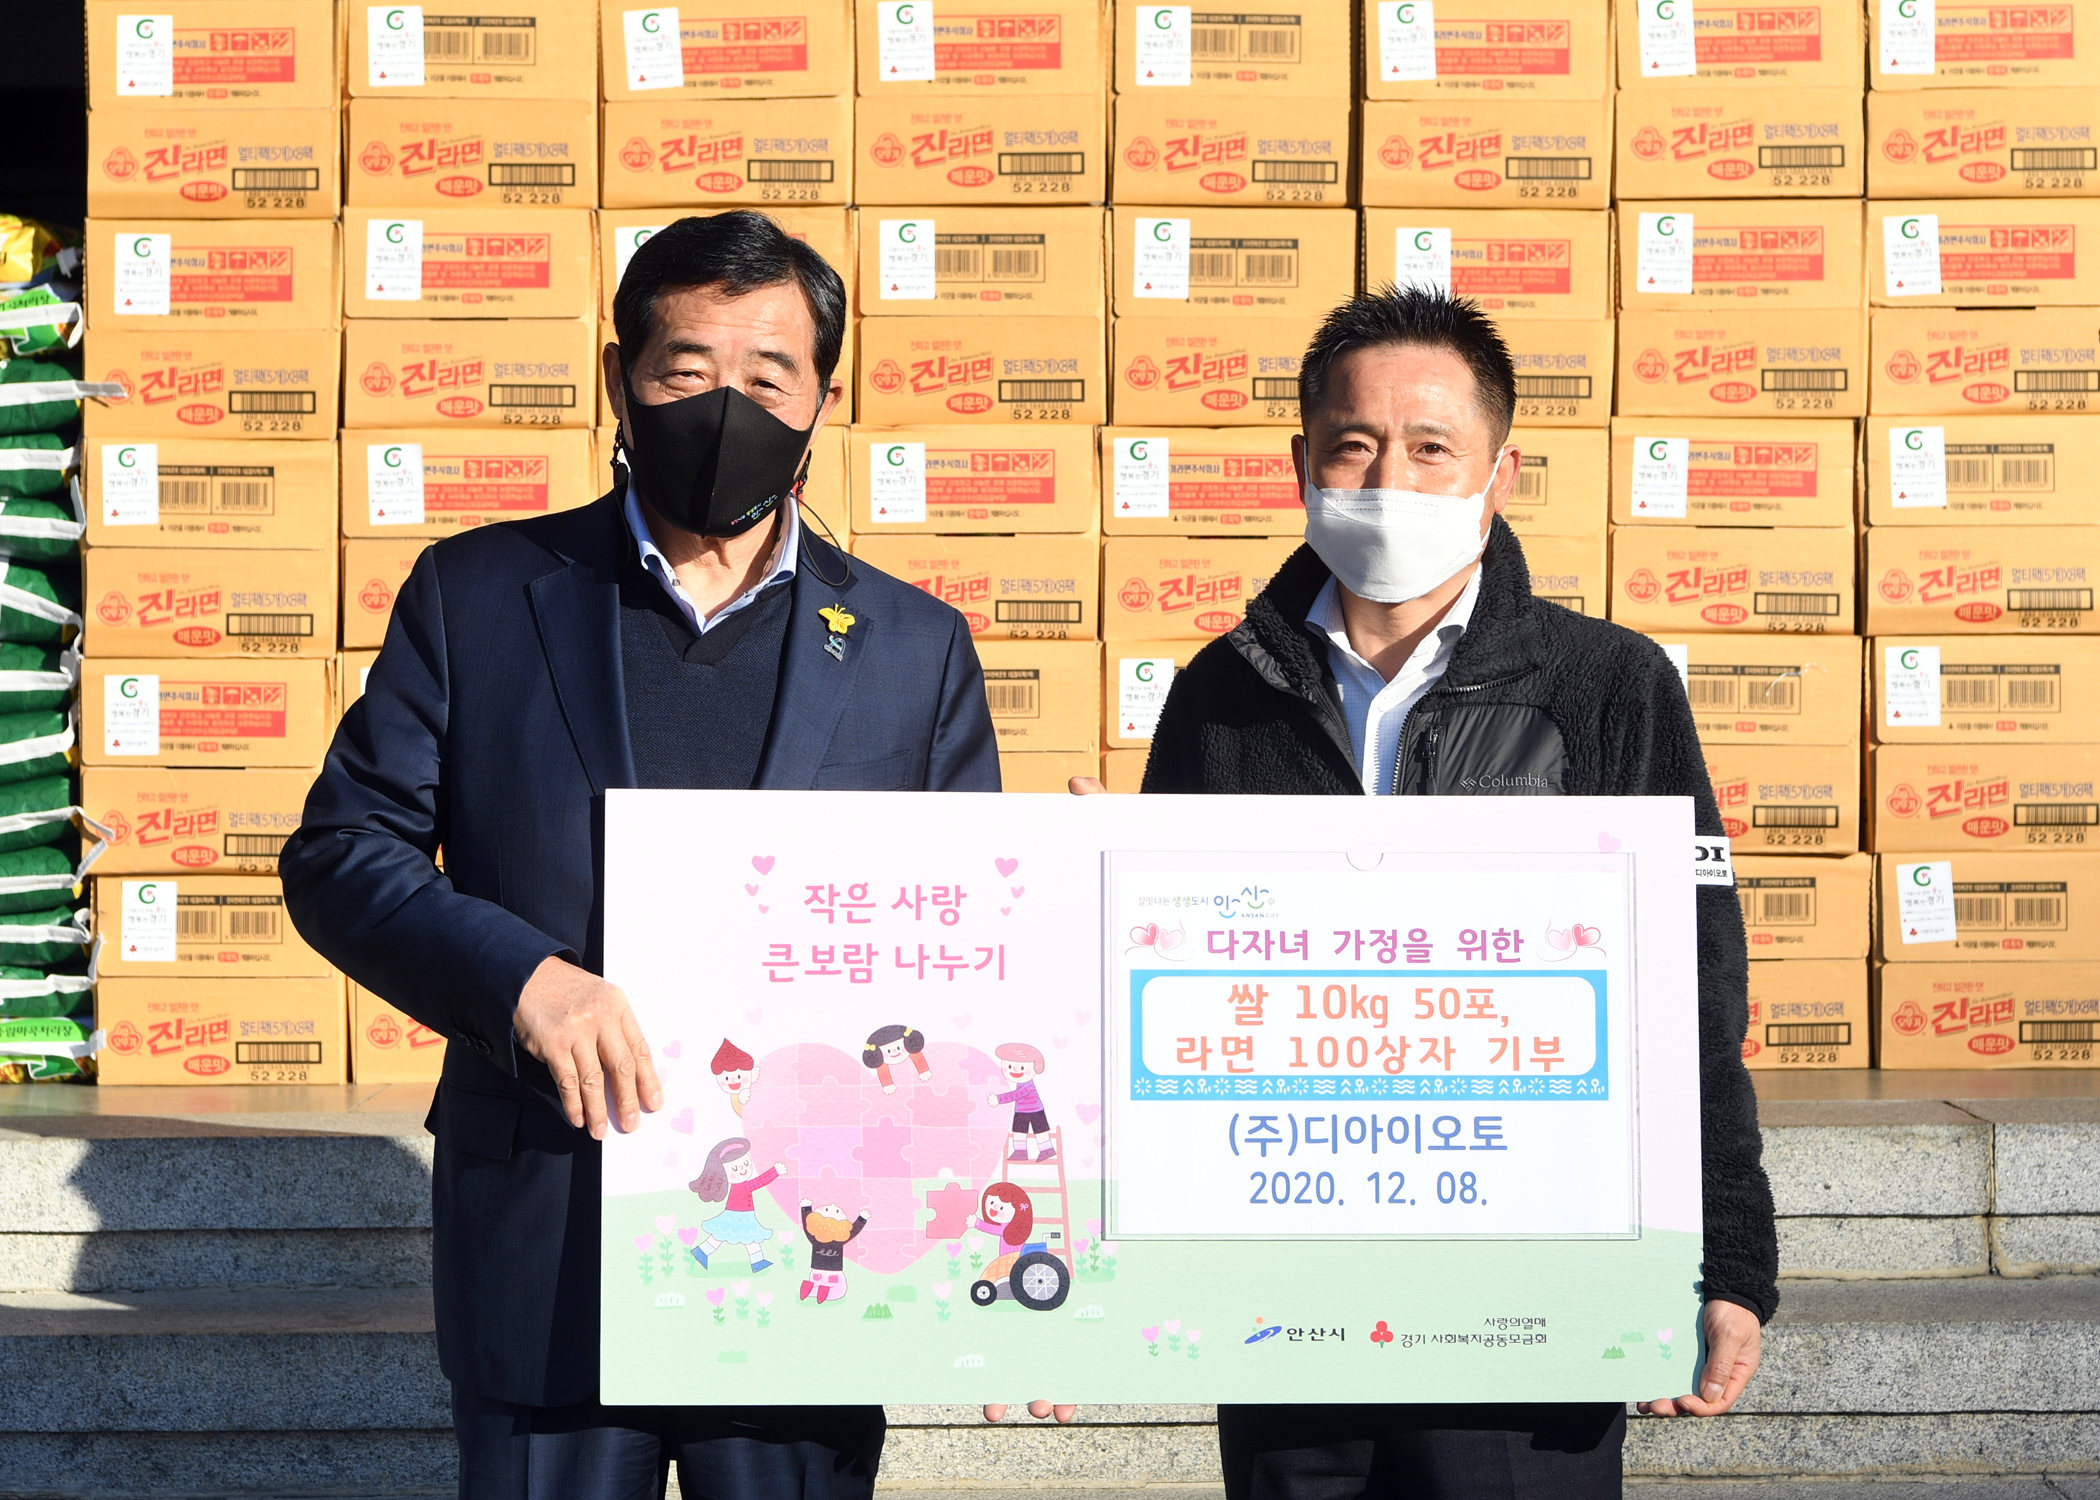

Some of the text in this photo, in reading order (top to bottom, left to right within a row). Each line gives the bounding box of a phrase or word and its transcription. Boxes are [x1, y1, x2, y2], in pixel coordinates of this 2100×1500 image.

[400, 140, 481, 177] 진라면
[660, 136, 742, 173] 진라면
[910, 130, 992, 167] 진라면
[1164, 136, 1246, 173] 진라면
[1418, 134, 1500, 171] 진라면
[1672, 122, 1753, 160] 진라면
[1922, 126, 2004, 163] 진라면
[144, 144, 226, 182] 진라면
[951, 170, 989, 184] 매운맛
[1458, 174, 1497, 188] 매운맛
[1711, 164, 1749, 178] 매운맛
[1963, 166, 2001, 180] 매운맛
[184, 184, 223, 199] 매운맛
[439, 180, 477, 194] 매운맛
[699, 176, 737, 190] 매운맛
[1203, 176, 1241, 190] 매운맛
[400, 360, 482, 397] 진라면
[910, 356, 992, 394] 진라면
[1166, 354, 1247, 391] 진라면
[1674, 346, 1755, 383] 진라면
[1926, 346, 2008, 384] 진라면
[140, 368, 222, 405] 진라면
[950, 396, 989, 411] 매운맛
[1205, 394, 1243, 408] 매운맛
[1713, 386, 1751, 400] 매운맛
[1966, 386, 2005, 401] 매운맛
[180, 408, 219, 422] 매운맛
[440, 400, 479, 415] 매운맛
[1158, 576, 1240, 613] 진라면
[1666, 568, 1747, 605] 진라면
[1918, 566, 2000, 603] 진라면
[138, 590, 219, 627] 진라면
[1705, 608, 1743, 622] 매운맛
[1959, 606, 1997, 621] 매운맛
[178, 630, 217, 645] 매운맛
[1479, 773, 1548, 789] Columbia
[1926, 780, 2008, 818] 진라면
[136, 808, 217, 846] 진라면
[1966, 820, 2005, 835] 매운맛
[175, 850, 213, 864] 매운맛
[804, 882, 967, 926] 작은 사랑
[1138, 896, 1171, 906] 살맛나는
[1172, 896, 1209, 907] 생생도시
[895, 944, 1004, 981] 나누기
[1208, 928, 1524, 964] 다자녀 가정을 위한
[1228, 984, 1508, 1028] 쌀 10kg 50포,
[1932, 998, 2014, 1035] 진라면
[148, 1018, 229, 1056] 진라면
[1177, 1036, 1564, 1074] 라면 100상자 기부
[1972, 1038, 2011, 1052] 매운맛
[187, 1058, 225, 1073] 매운맛
[1229, 1113, 1507, 1157] (주)디아이오토
[1250, 1171, 1487, 1206] 2020. 12. 08.
[1287, 1328, 1344, 1341] 안산시
[1401, 1334, 1546, 1348] 경기 사회복지공동모금회
[1484, 1318, 1546, 1330] 사랑의열매
